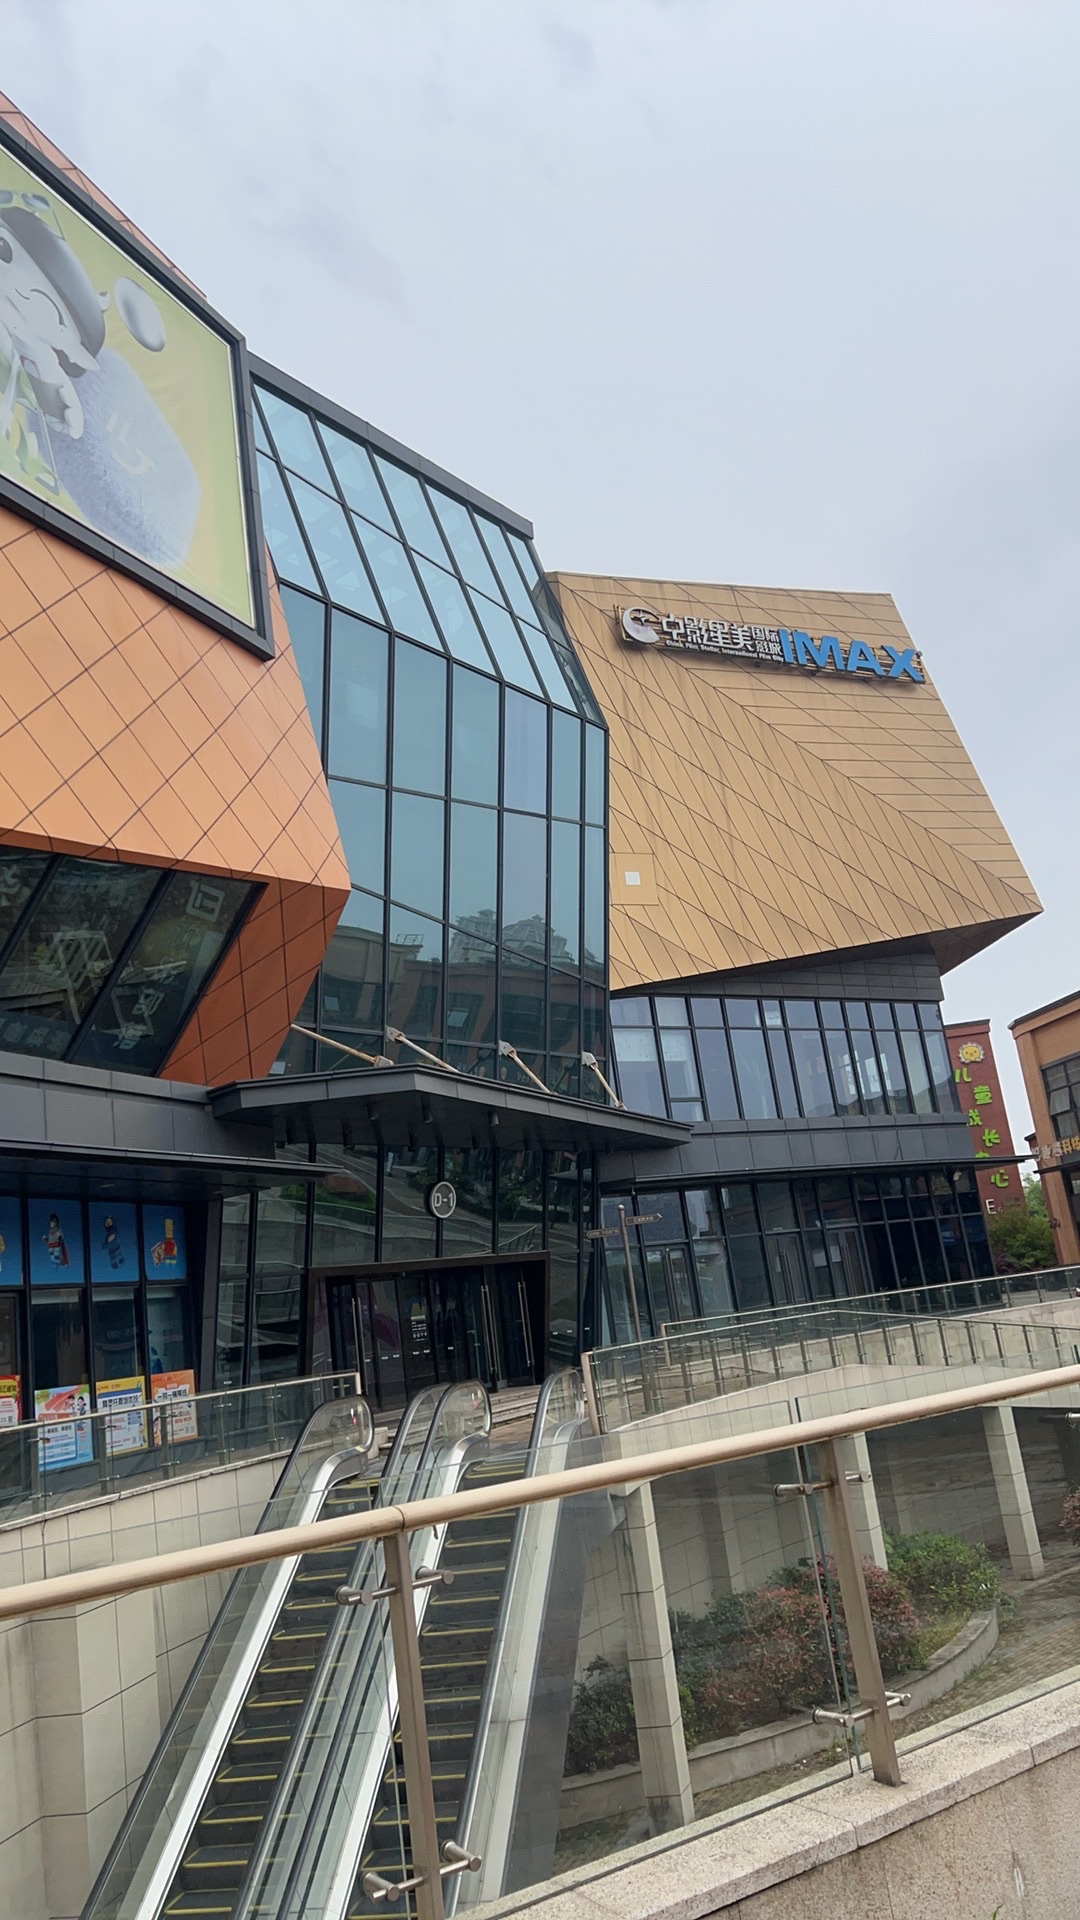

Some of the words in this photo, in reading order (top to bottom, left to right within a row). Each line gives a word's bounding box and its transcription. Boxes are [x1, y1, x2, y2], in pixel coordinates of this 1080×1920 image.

[751, 626, 780, 642] 国际
[755, 640, 783, 656] 影城
[778, 628, 925, 683] IMAX
[955, 1067, 1010, 1188] 儿童成长心
[435, 1192, 454, 1207] D-1
